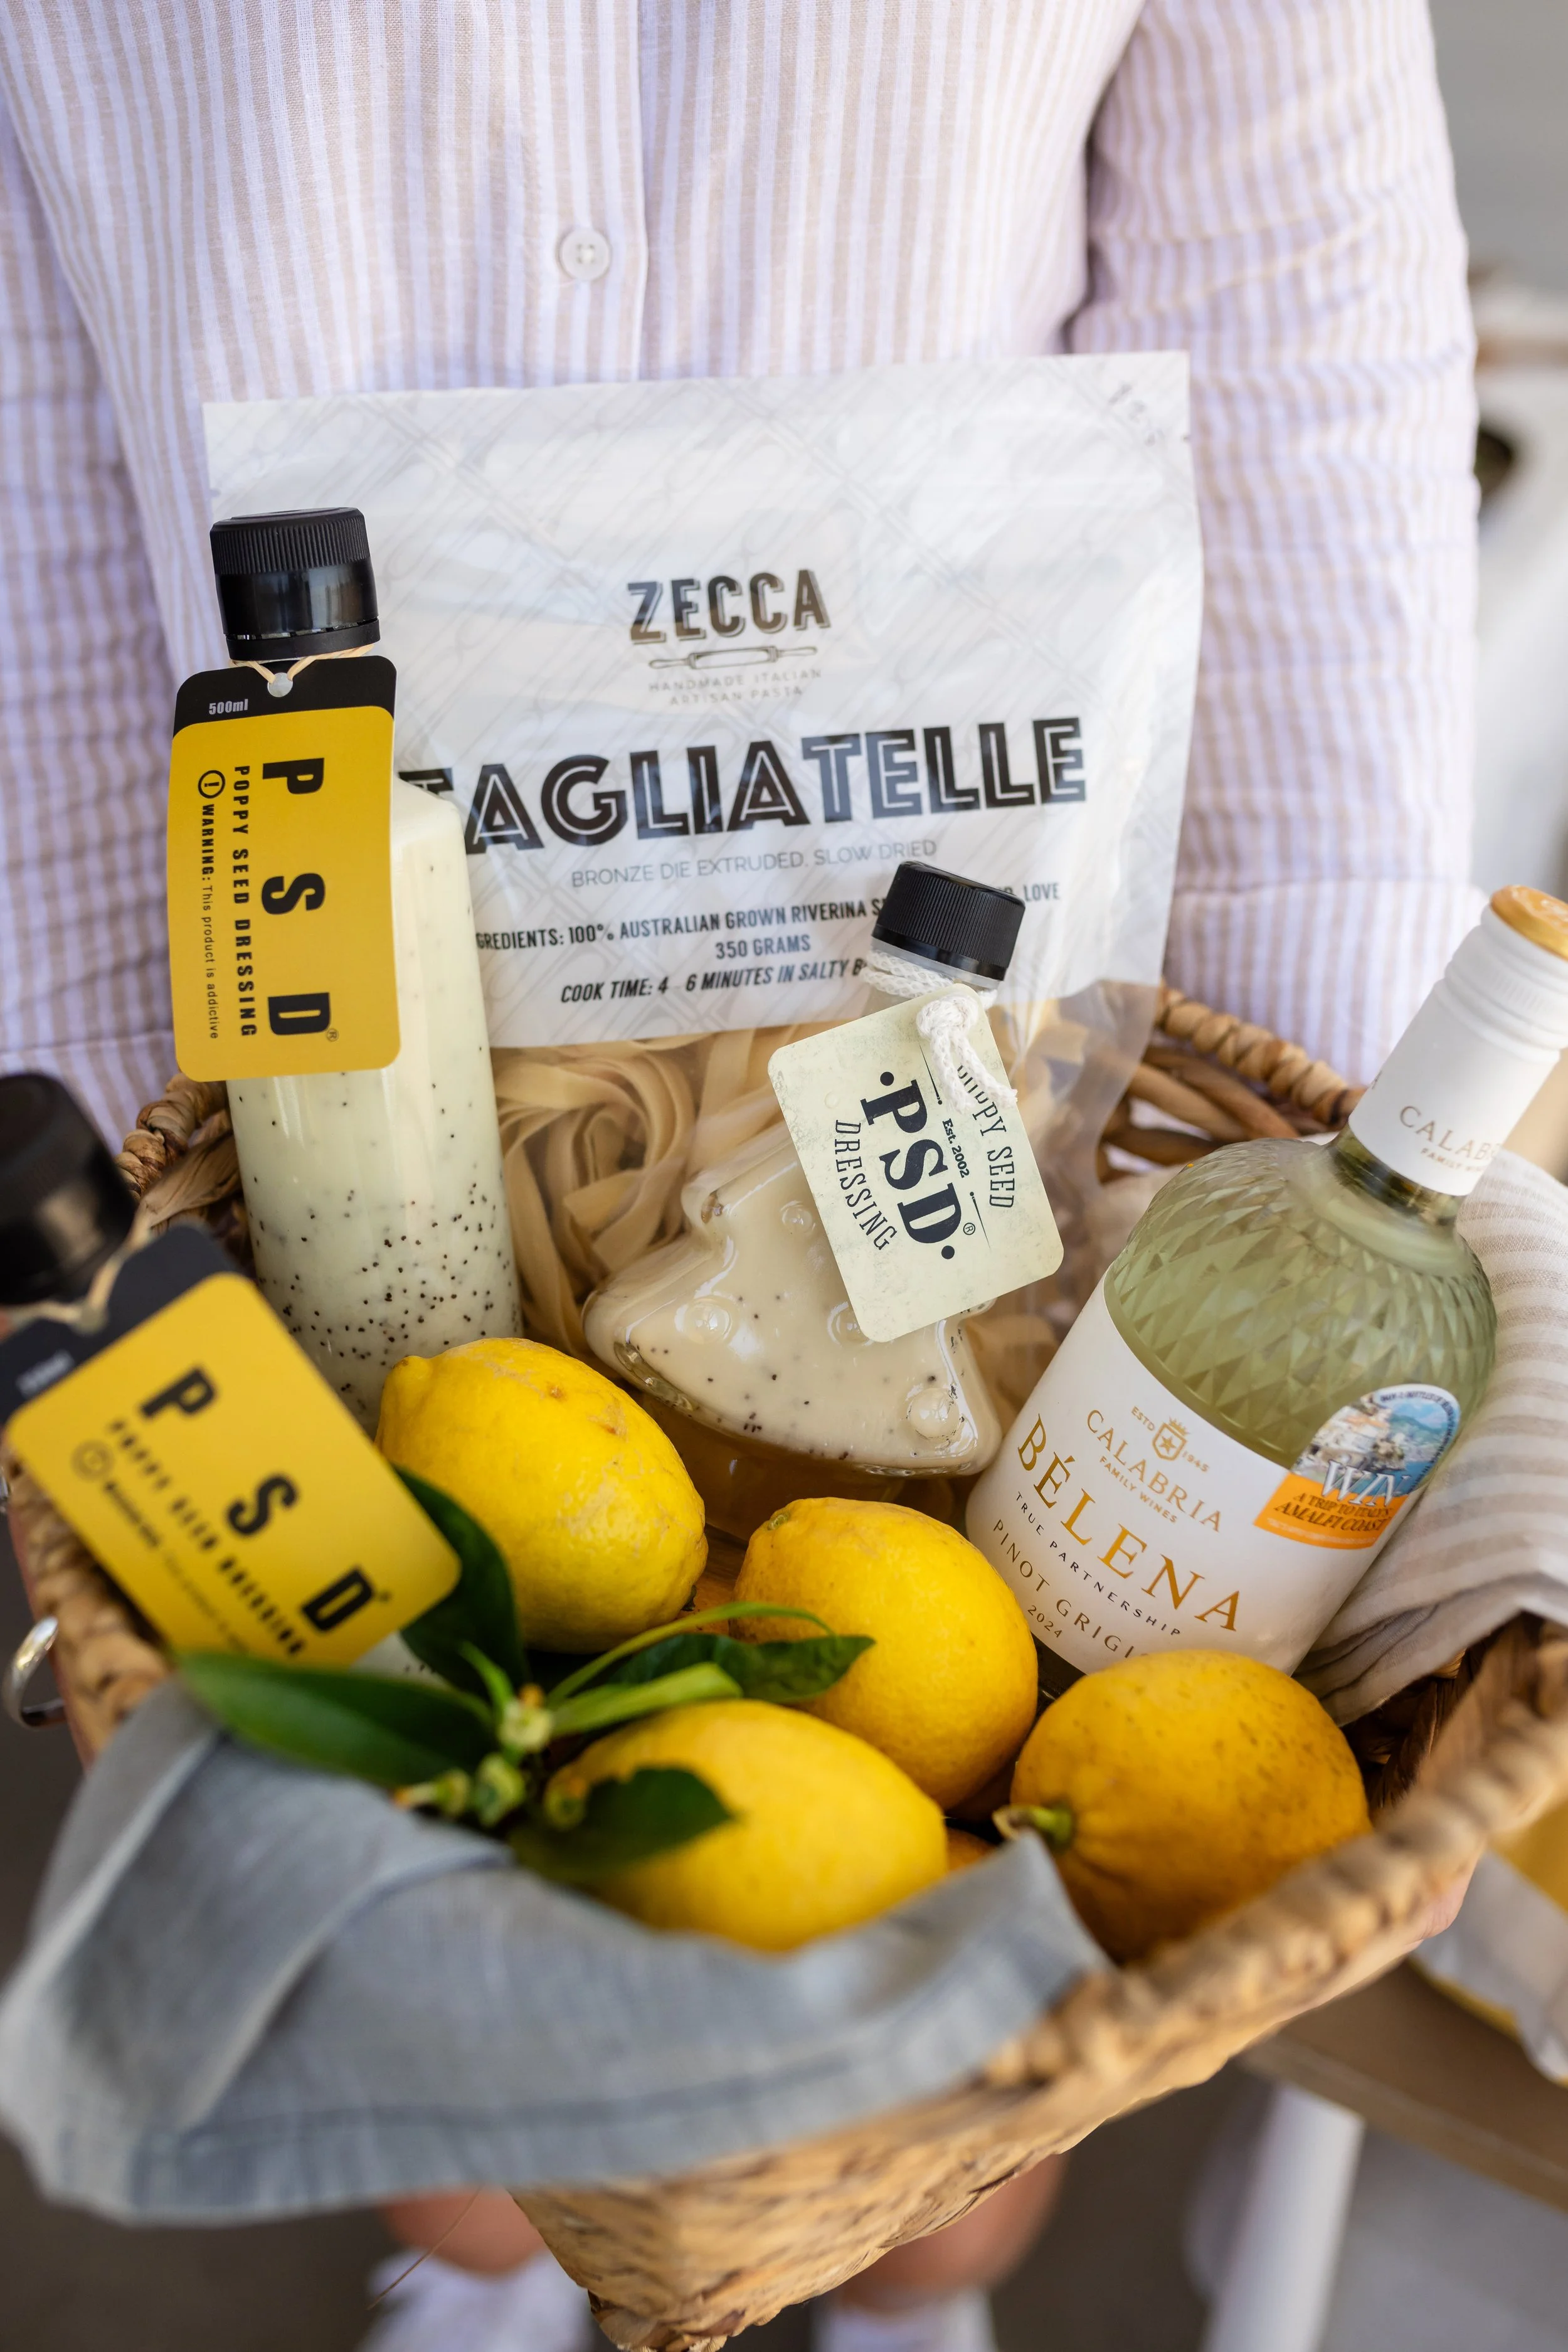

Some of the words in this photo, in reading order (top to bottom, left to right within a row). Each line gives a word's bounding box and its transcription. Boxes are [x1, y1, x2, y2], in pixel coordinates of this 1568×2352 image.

[627, 568, 831, 645] ZECCA
[208, 698, 249, 716] 500ml
[648, 674, 744, 693] HANDMADE
[232, 765, 250, 836] POPPY
[201, 803, 215, 881] WARNING:
[572, 863, 654, 888] BRONZE
[660, 862, 691, 879] DIE
[814, 845, 872, 866] SLOW
[879, 839, 938, 859] DRIED
[201, 885, 211, 911] This
[232, 847, 250, 905] SEED
[1023, 882, 1061, 902] LOVE
[201, 916, 216, 965] product
[476, 927, 564, 950] GREDIENTS:
[620, 911, 721, 940] AUSTRALIAN
[725, 906, 787, 930] GROWN
[791, 899, 867, 923] RIVERINA
[716, 940, 748, 960] 350
[753, 934, 812, 956] GRAMS
[206, 967, 216, 978] is
[234, 918, 258, 1037] DRESSING
[561, 980, 603, 1004] COOK
[610, 978, 653, 999] TIME:
[658, 976, 669, 994] 4
[686, 973, 697, 992] 6
[701, 963, 772, 990] MINUTES
[777, 962, 795, 982] IN
[798, 957, 851, 981] SALTY
[206, 982, 219, 1040] addictive
[860, 1079, 963, 1244] PSD
[941, 1118, 958, 1145] Est.
[951, 1145, 970, 1179] 2002
[987, 1146, 1016, 1209] SEED
[834, 1119, 898, 1251] DRESSING
[1131, 1406, 1155, 1432] ESTD
[1181, 1450, 1209, 1473] 1945
[1087, 1409, 1221, 1533] CALABRIA
[1099, 1455, 1137, 1492] FAMILY
[1139, 1491, 1178, 1523] WINES
[1322, 1459, 1412, 1507] WIN
[1017, 1413, 1239, 1632] BÉLENA
[1274, 1501, 1340, 1529] AMALFI
[1308, 1494, 1337, 1510] TRIP
[993, 1519, 1051, 1592] PINOT
[1056, 1598, 1149, 1659] GRIGI
[1015, 1491, 1044, 1536] TRUE
[1049, 1540, 1181, 1636] PARTNERSHIP
[1027, 1604, 1063, 1638] 2024
